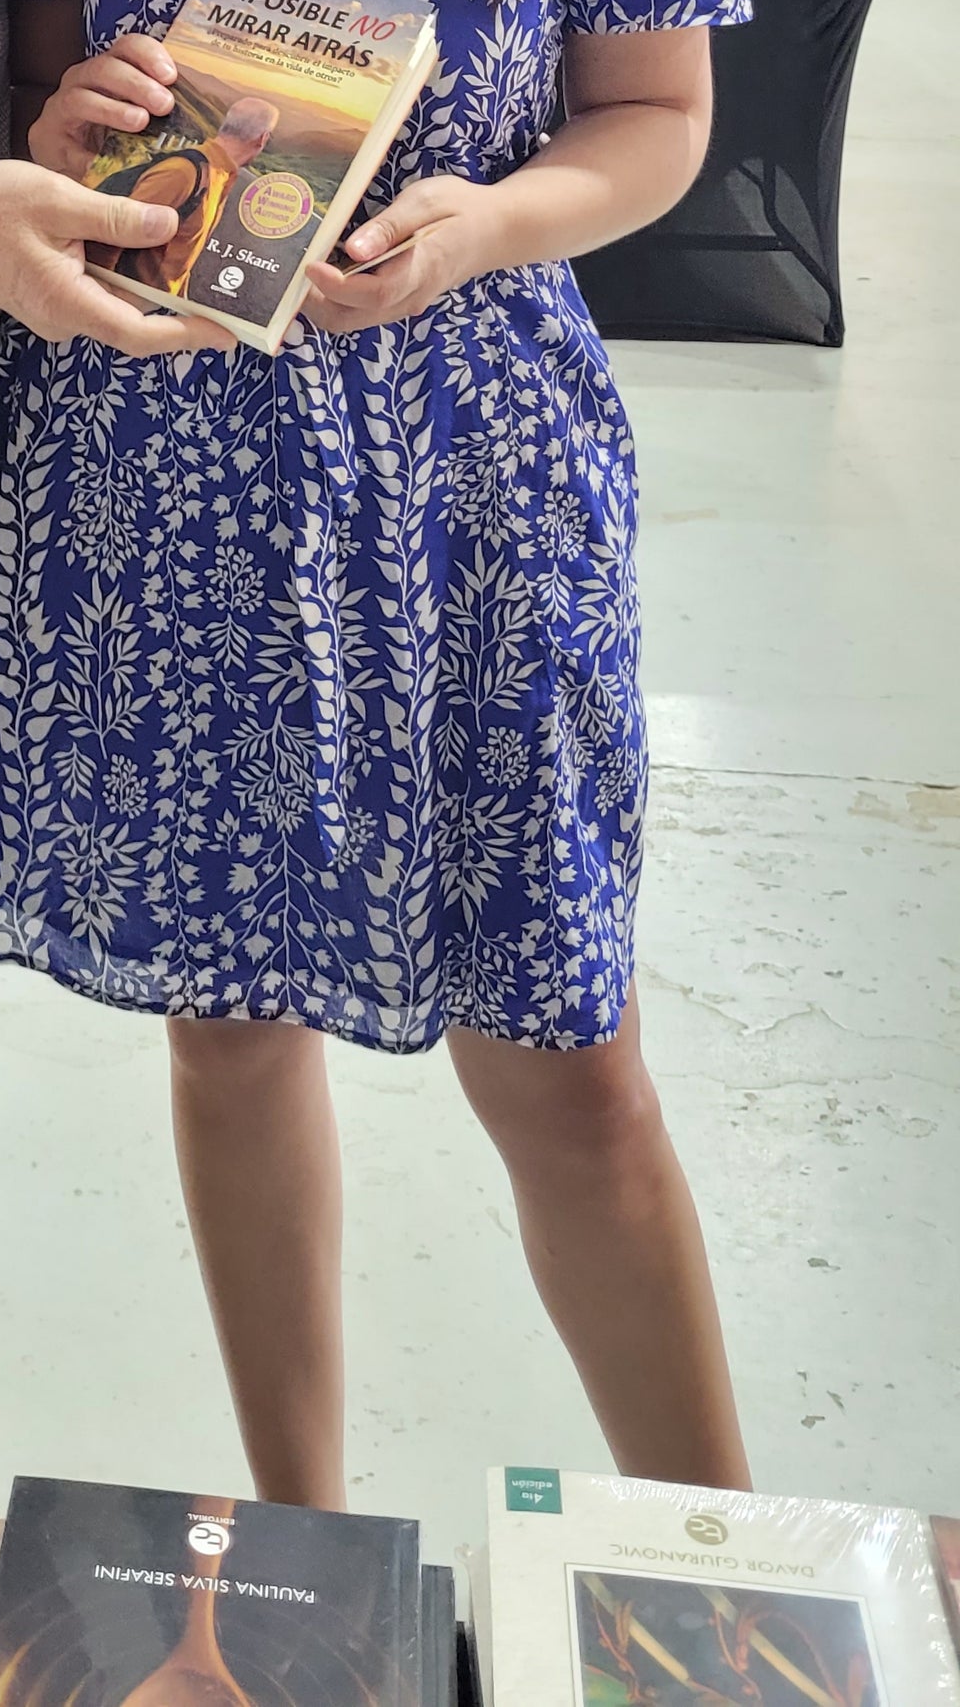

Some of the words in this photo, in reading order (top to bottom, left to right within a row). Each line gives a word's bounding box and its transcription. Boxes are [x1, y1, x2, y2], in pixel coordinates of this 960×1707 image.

[207, 5, 291, 43] MIRAR
[291, 31, 374, 68] ATRÁS
[348, 15, 396, 41] NO
[211, 38, 221, 47] de
[222, 42, 232, 51] tu
[232, 44, 264, 61] historia
[265, 56, 276, 64] en
[286, 61, 303, 72] vida
[303, 67, 315, 76] de
[315, 71, 343, 84] otros?
[251, 42, 271, 52] para
[312, 60, 322, 68] el
[322, 62, 355, 78] impacto
[206, 238, 221, 254] R.
[221, 243, 234, 259] J.
[235, 248, 280, 273] Skaric
[511, 1479, 553, 1490] edición
[521, 1492, 544, 1505] 4ta
[187, 1512, 236, 1526] EDITORIAL
[609, 1543, 739, 1570] GJURANOVIC
[746, 1558, 815, 1579] DAVOR
[94, 1564, 176, 1587] SERAFINI
[180, 1573, 230, 1594] SILVA
[234, 1580, 317, 1604] PAULINA
